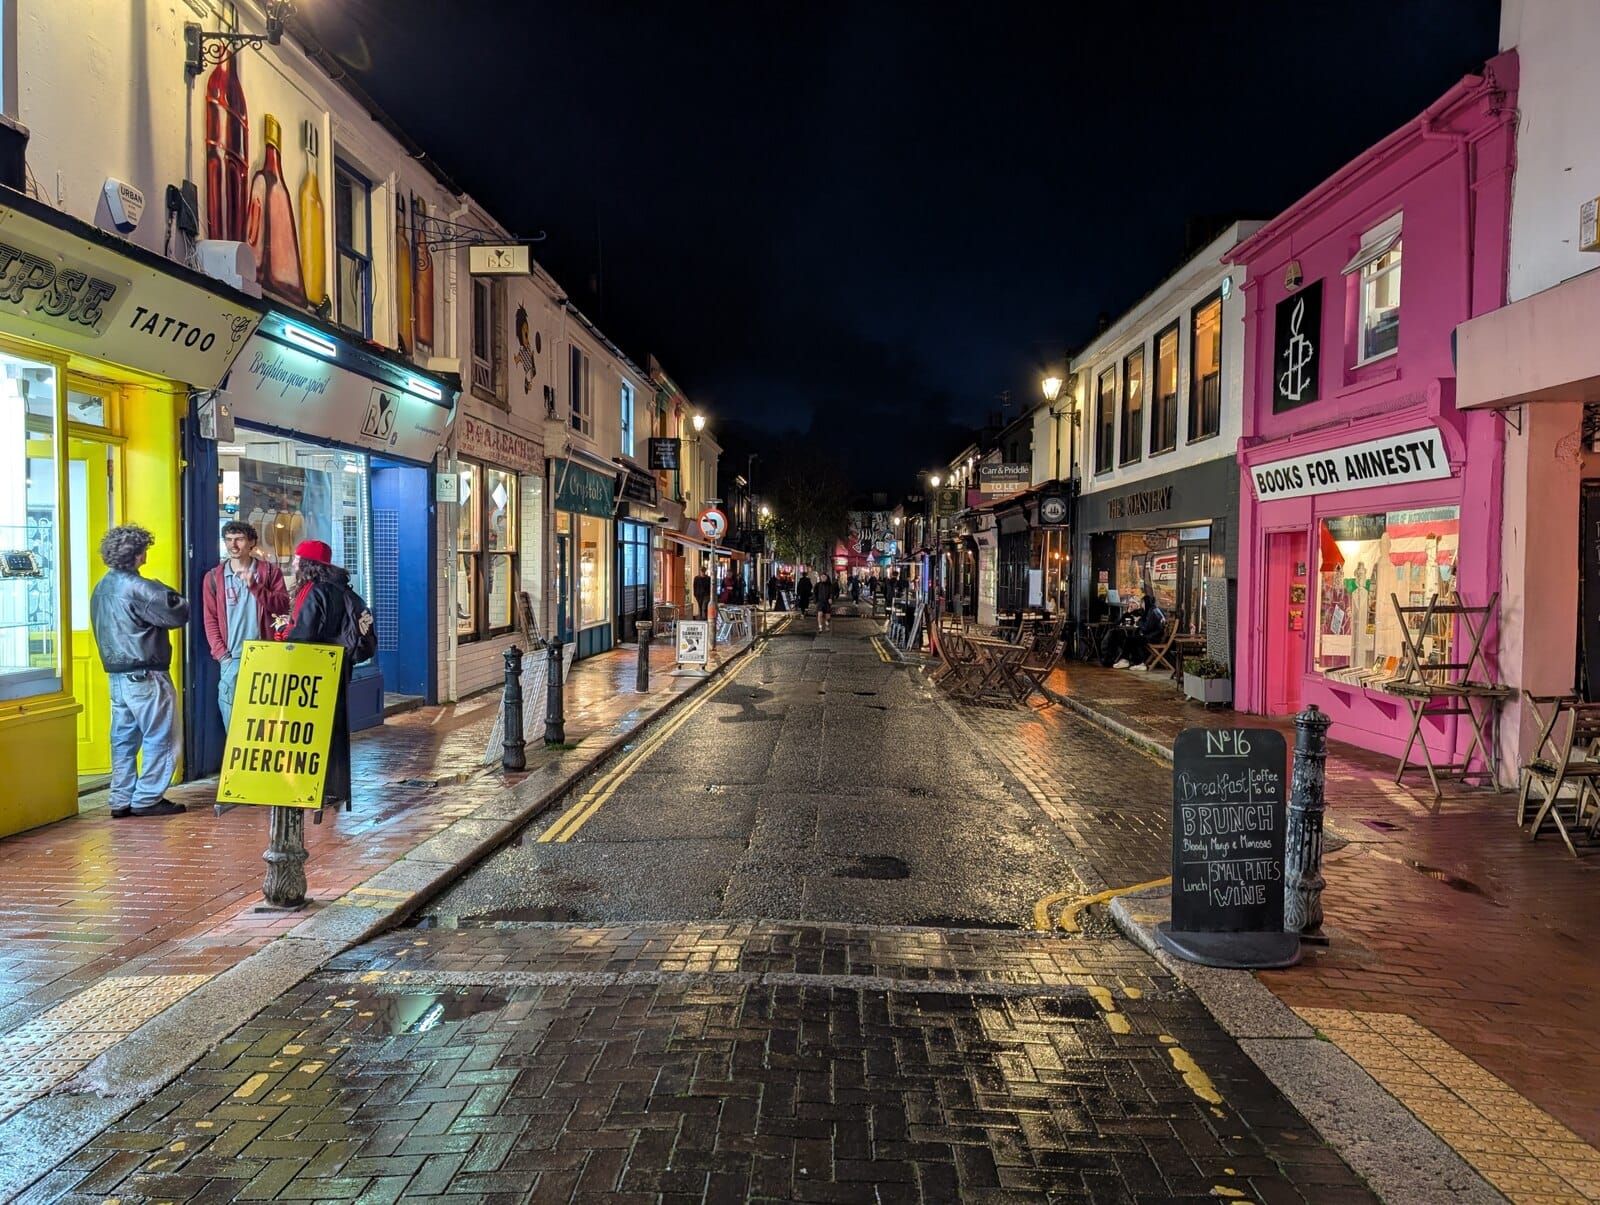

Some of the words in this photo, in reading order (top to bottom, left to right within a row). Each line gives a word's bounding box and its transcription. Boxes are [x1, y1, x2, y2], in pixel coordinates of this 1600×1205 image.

[120, 186, 143, 204] URBAN
[130, 306, 216, 352] TATTOO
[248, 351, 289, 391] Brighton
[280, 372, 308, 398] your
[981, 466, 998, 475] Carr
[1004, 465, 1029, 474] Priddle
[1256, 465, 1303, 494] BOOKS
[1306, 459, 1340, 487] FOR
[1344, 439, 1436, 481] AMNESTY
[569, 473, 603, 504] Crystals
[1107, 497, 1123, 519] THE
[1126, 485, 1171, 517] ROASTERY
[248, 672, 322, 709] ECLIPSE
[246, 718, 314, 745] TATTOO
[1233, 729, 1251, 755] 16
[229, 747, 320, 775] PIERCING
[1179, 771, 1249, 801] Breakfast
[1251, 769, 1278, 782] Coffee
[1252, 782, 1262, 794] To
[1264, 782, 1276, 794] Go
[1182, 805, 1274, 836] BRUNCH
[1182, 838, 1208, 860] Bloody
[1240, 834, 1272, 849] Mimosas
[1182, 877, 1208, 892] Lunch
[1210, 862, 1242, 882] SMALL
[1245, 861, 1281, 881] PLATES
[1213, 885, 1267, 907] WINE
